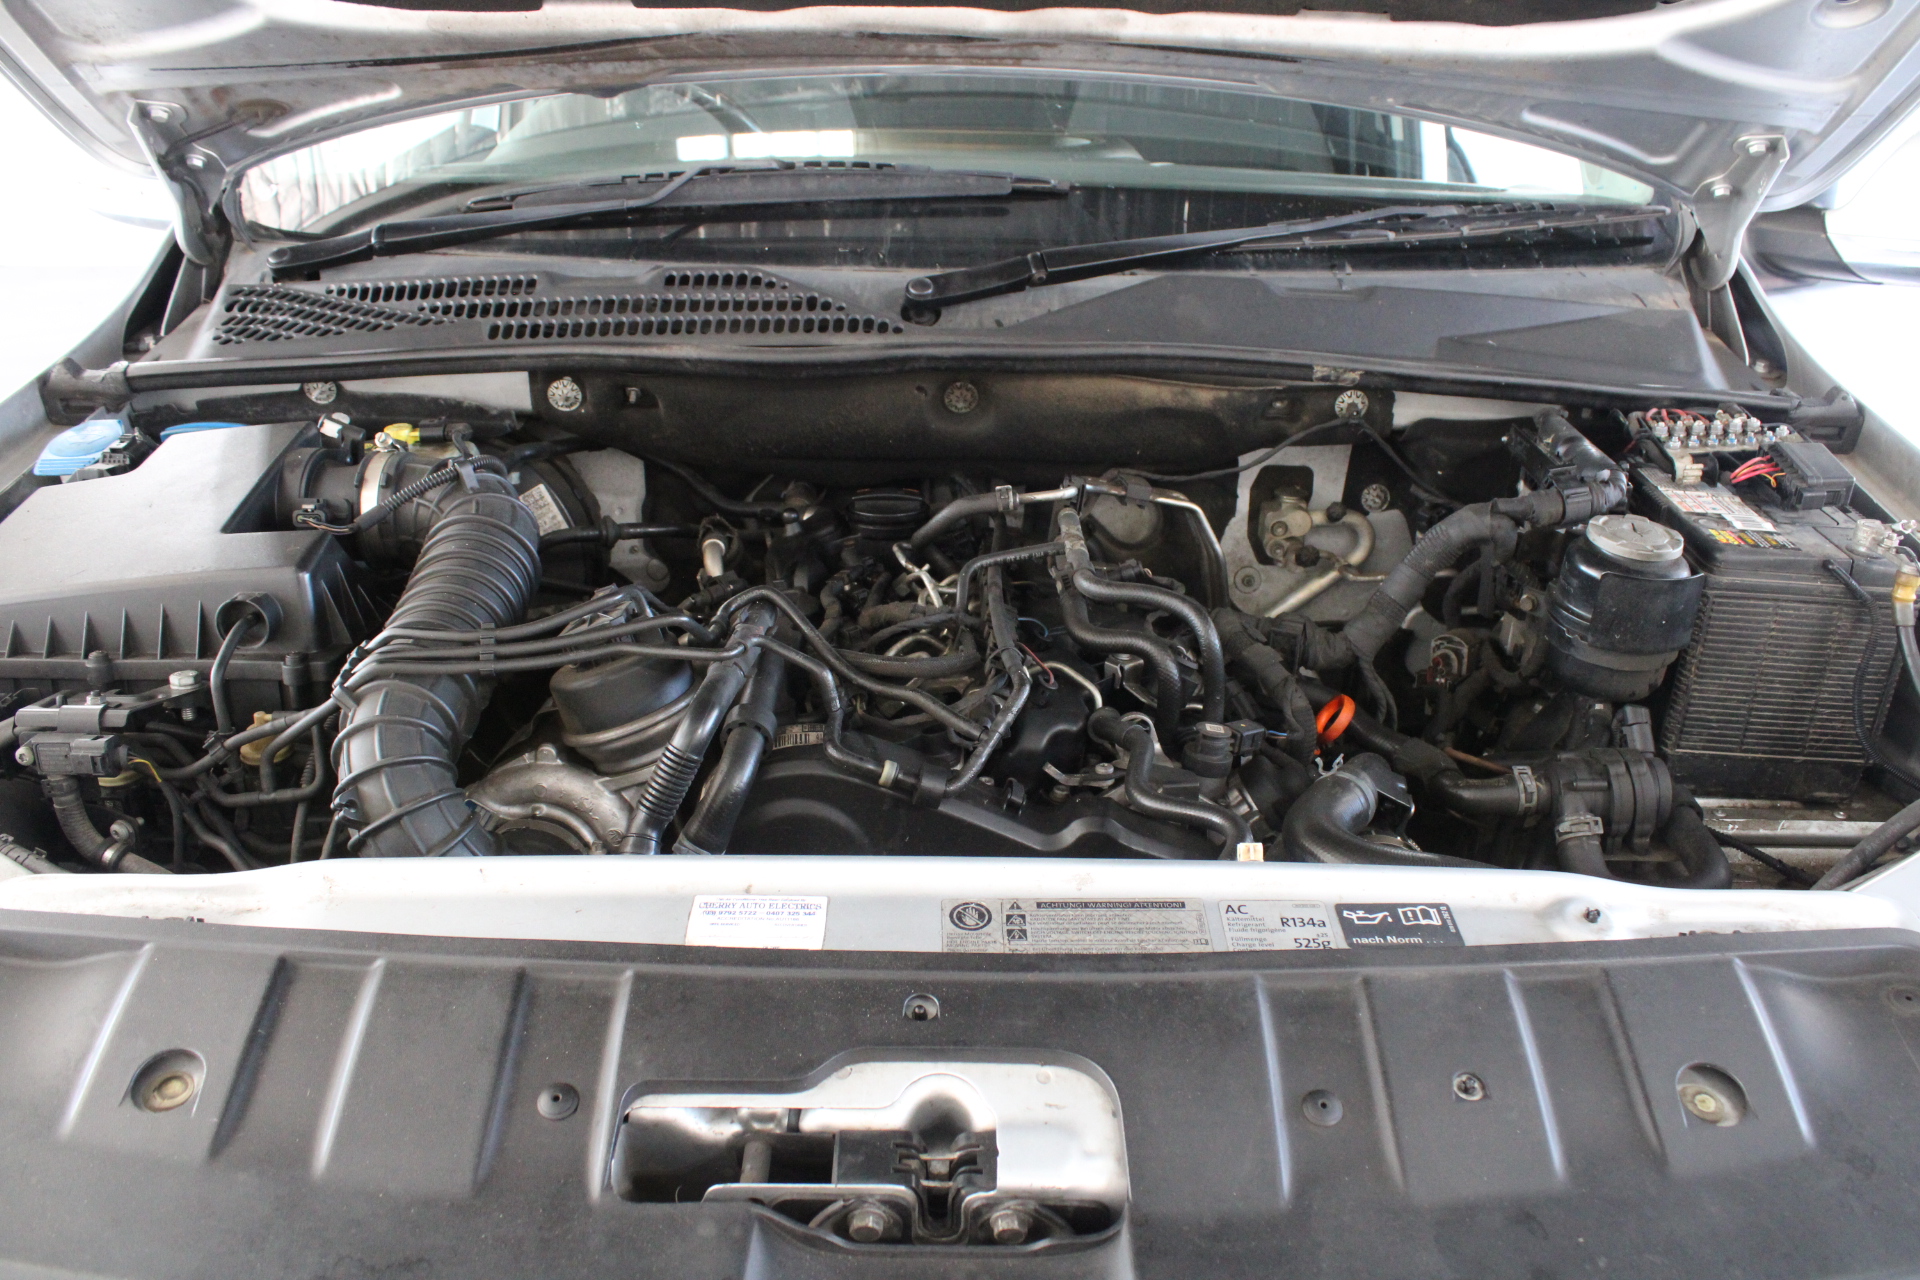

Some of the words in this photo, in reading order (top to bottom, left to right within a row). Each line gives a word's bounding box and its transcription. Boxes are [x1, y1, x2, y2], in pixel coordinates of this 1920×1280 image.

[768, 902, 823, 910] ELECTRICS
[1225, 904, 1248, 914] AC
[1280, 917, 1327, 927] R134a
[1294, 938, 1331, 950] 525g
[1353, 935, 1384, 943] nach
[1386, 935, 1423, 943] Norm
